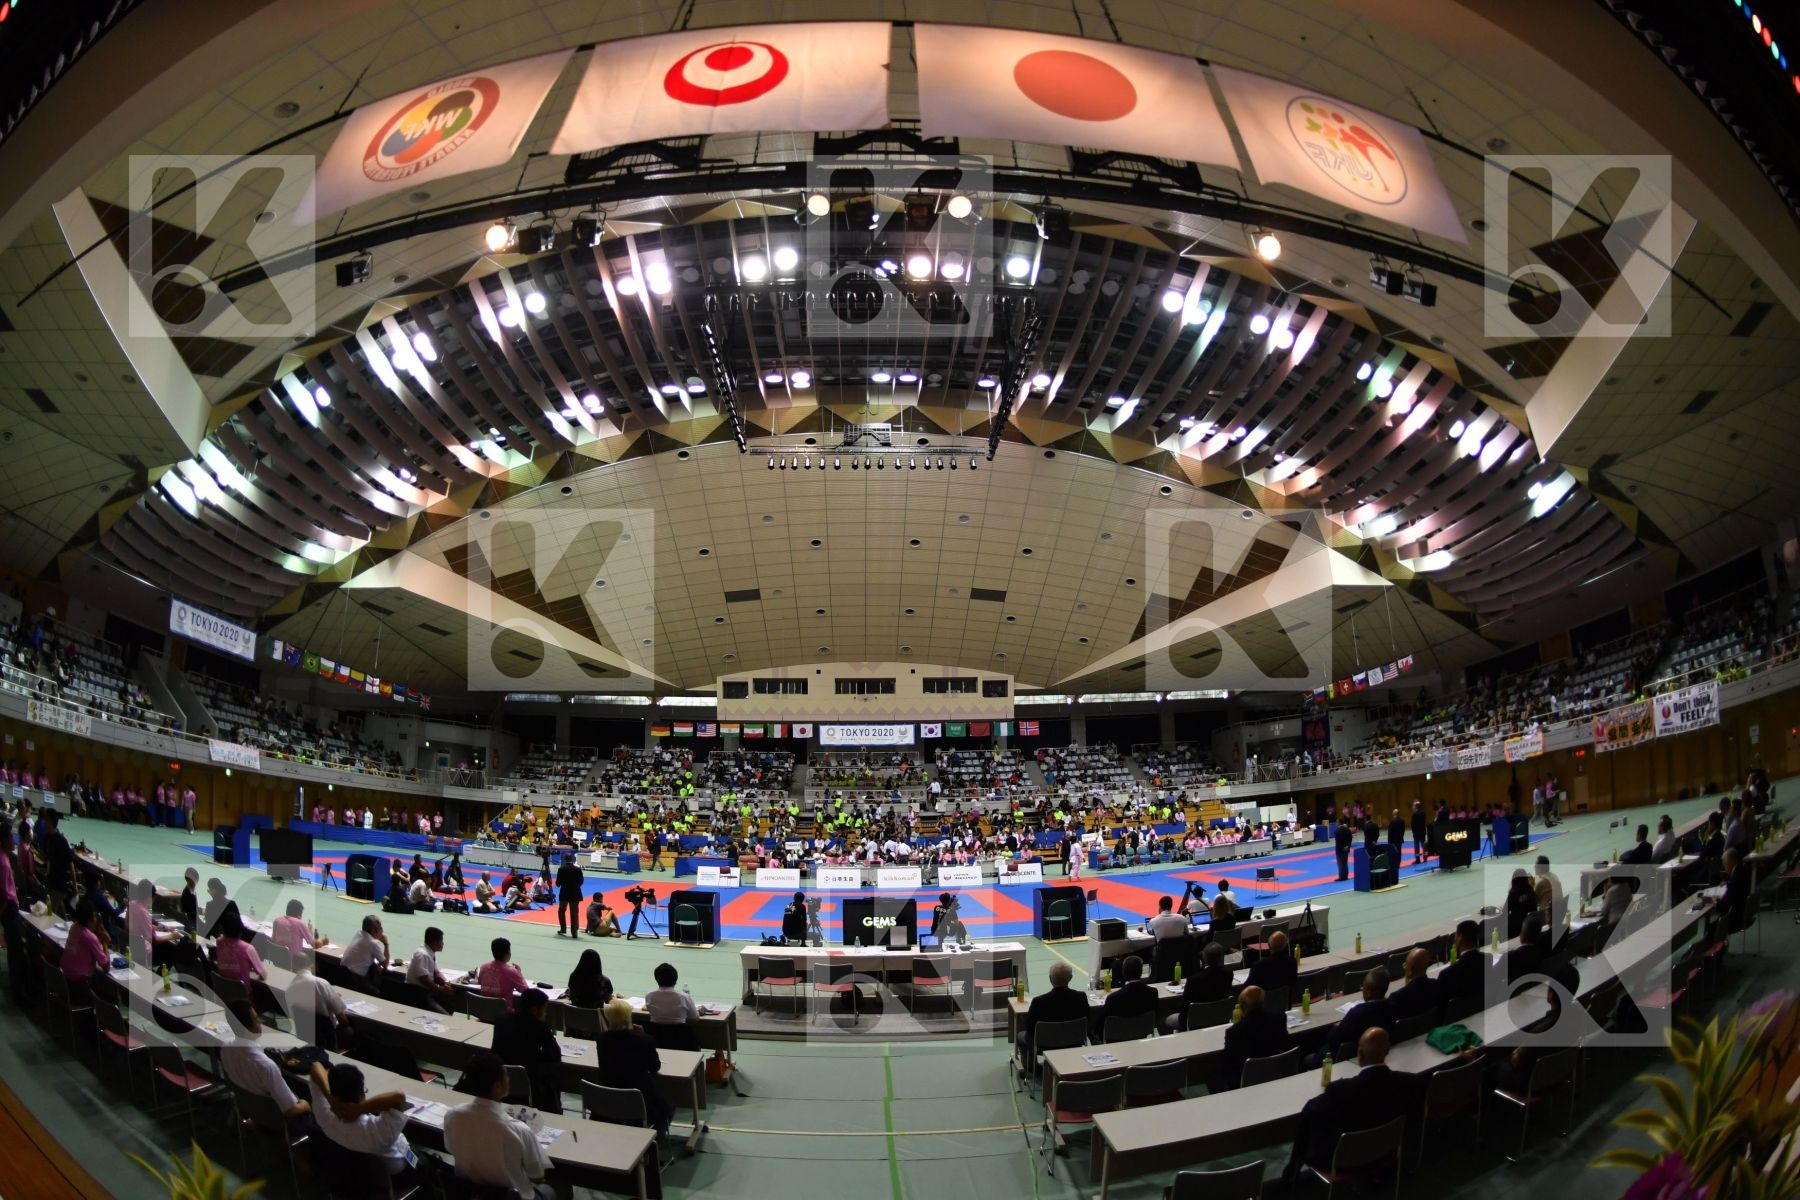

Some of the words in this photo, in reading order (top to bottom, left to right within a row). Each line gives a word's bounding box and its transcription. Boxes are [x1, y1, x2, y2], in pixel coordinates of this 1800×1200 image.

[191, 612, 219, 633] TOKYO
[219, 624, 239, 642] 2020
[1680, 707, 1705, 723] FEEL!
[840, 728, 870, 737] TOKYO
[872, 728, 894, 737] 2020
[1444, 830, 1468, 841] GEMS
[862, 916, 897, 927] GEMS
